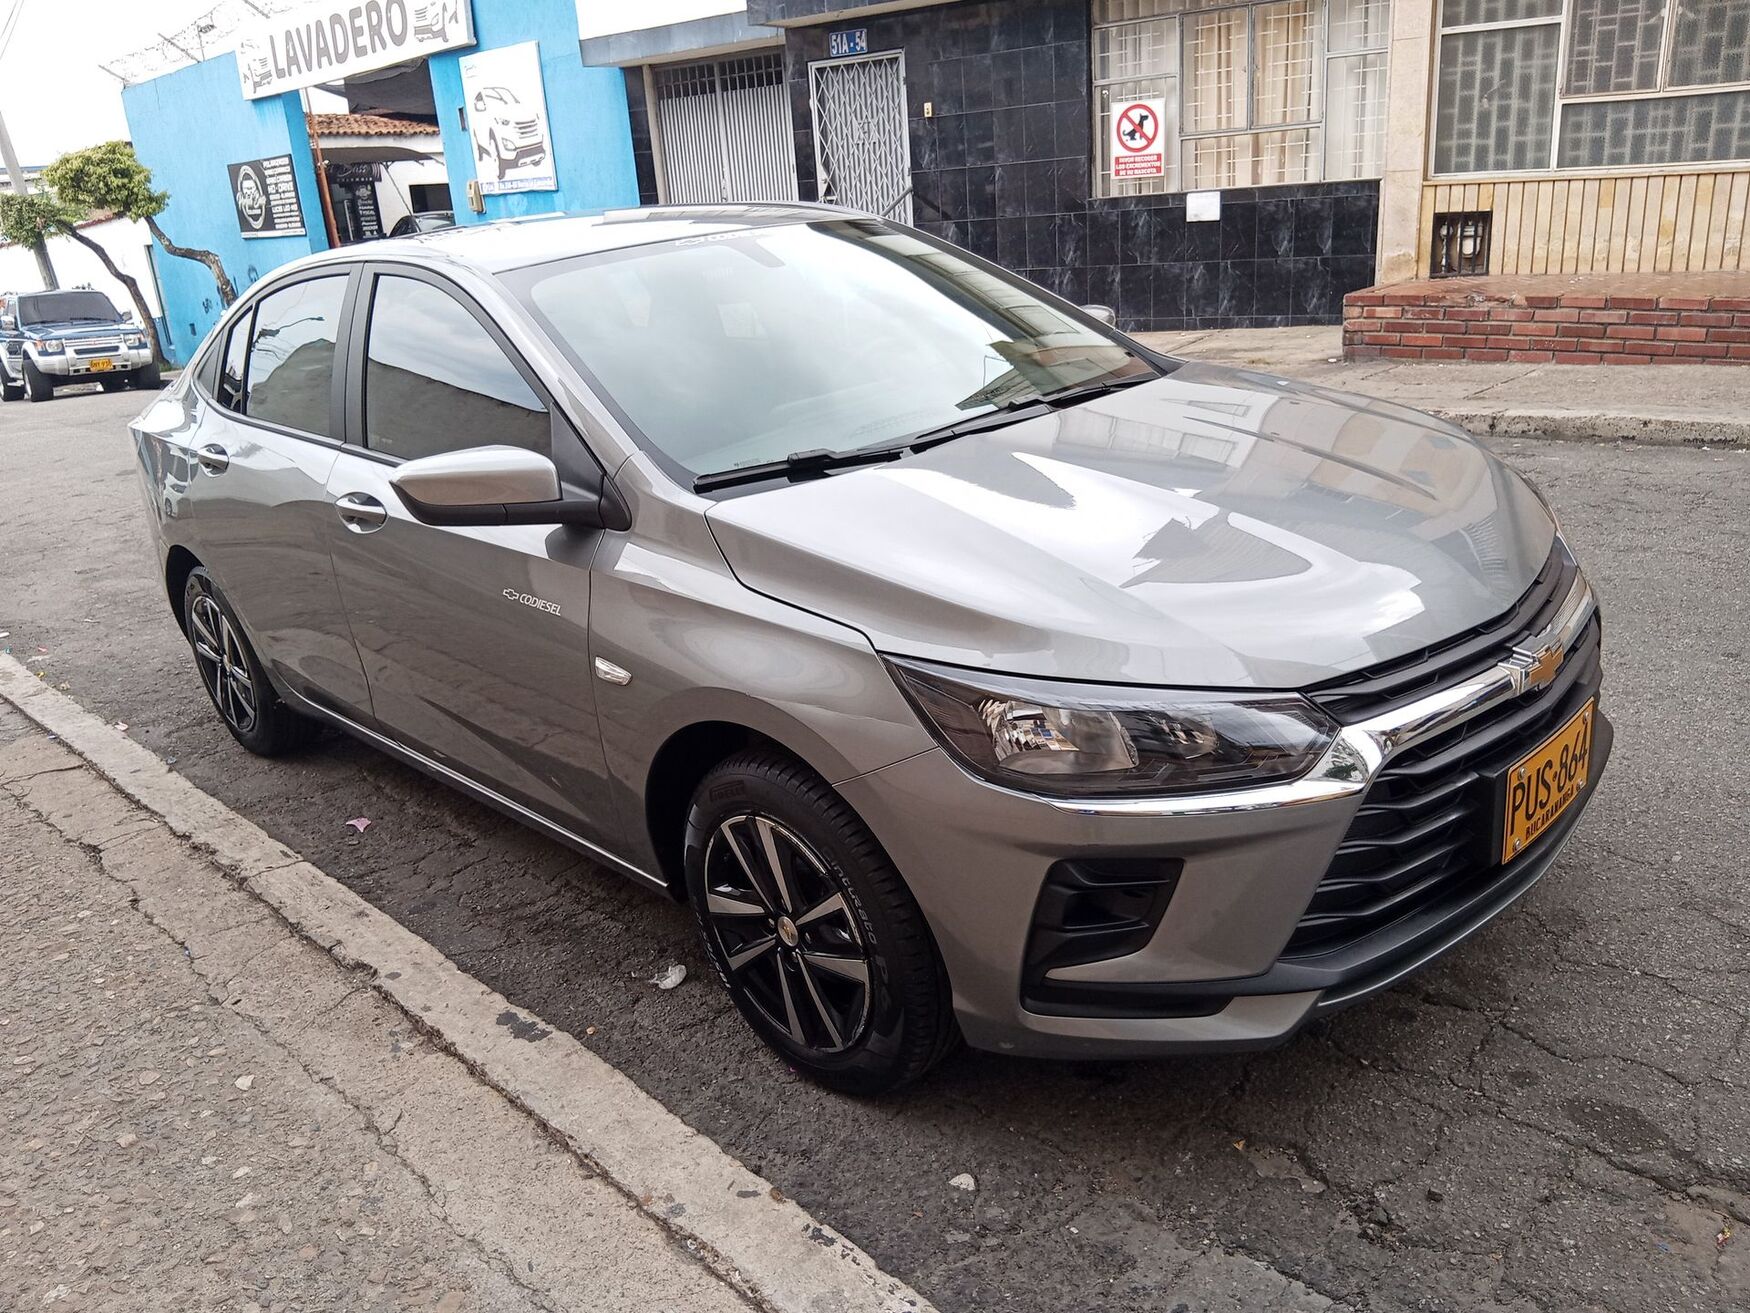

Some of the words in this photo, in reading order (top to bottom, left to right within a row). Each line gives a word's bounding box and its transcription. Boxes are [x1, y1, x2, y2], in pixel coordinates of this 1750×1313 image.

[269, 0, 408, 79] LAVADERO
[831, 33, 849, 55] 51A
[519, 593, 561, 616] CODIESEL
